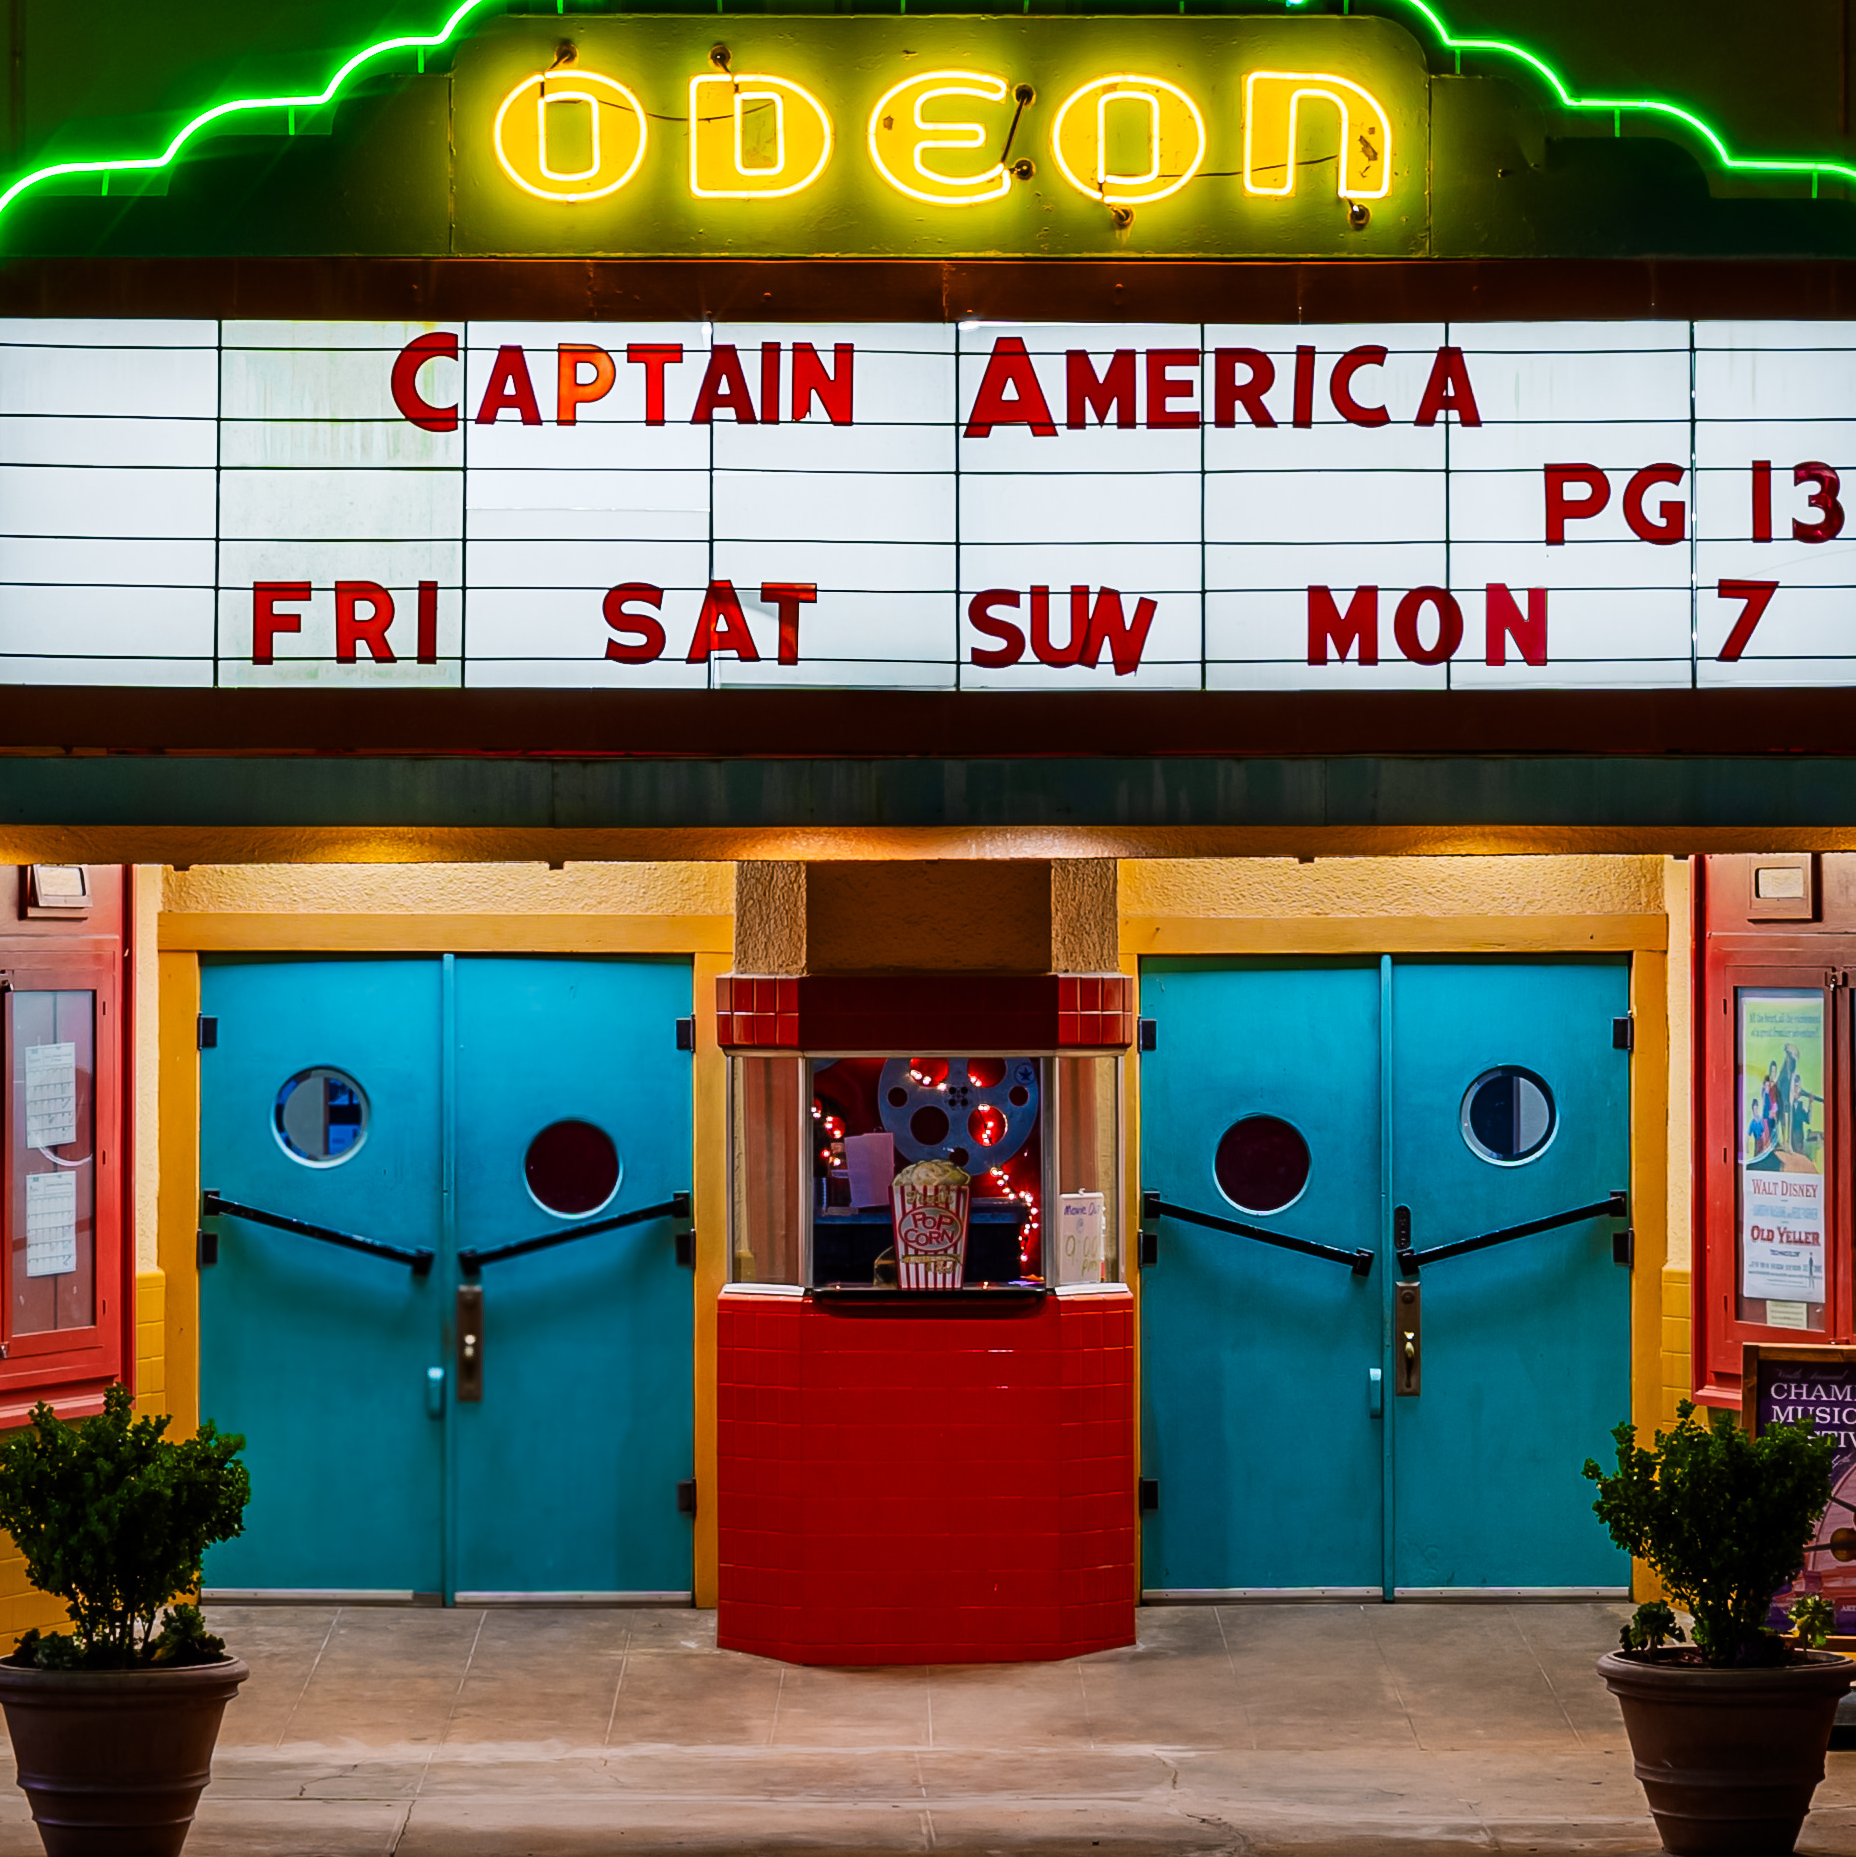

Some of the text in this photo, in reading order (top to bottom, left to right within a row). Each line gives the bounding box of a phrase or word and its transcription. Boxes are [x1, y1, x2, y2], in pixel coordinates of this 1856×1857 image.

[490, 67, 1396, 206] ODEON
[391, 331, 1483, 438] CAPTAIN AMERICA
[1544, 460, 1846, 546] PG 13
[252, 579, 1781, 677] FRI SAT SUN MON 7
[1751, 1178, 1819, 1198] WALT DISNEY
[904, 1228, 956, 1247] CORN
[911, 1211, 955, 1231] POP
[1750, 1225, 1822, 1247] OLD YELLER
